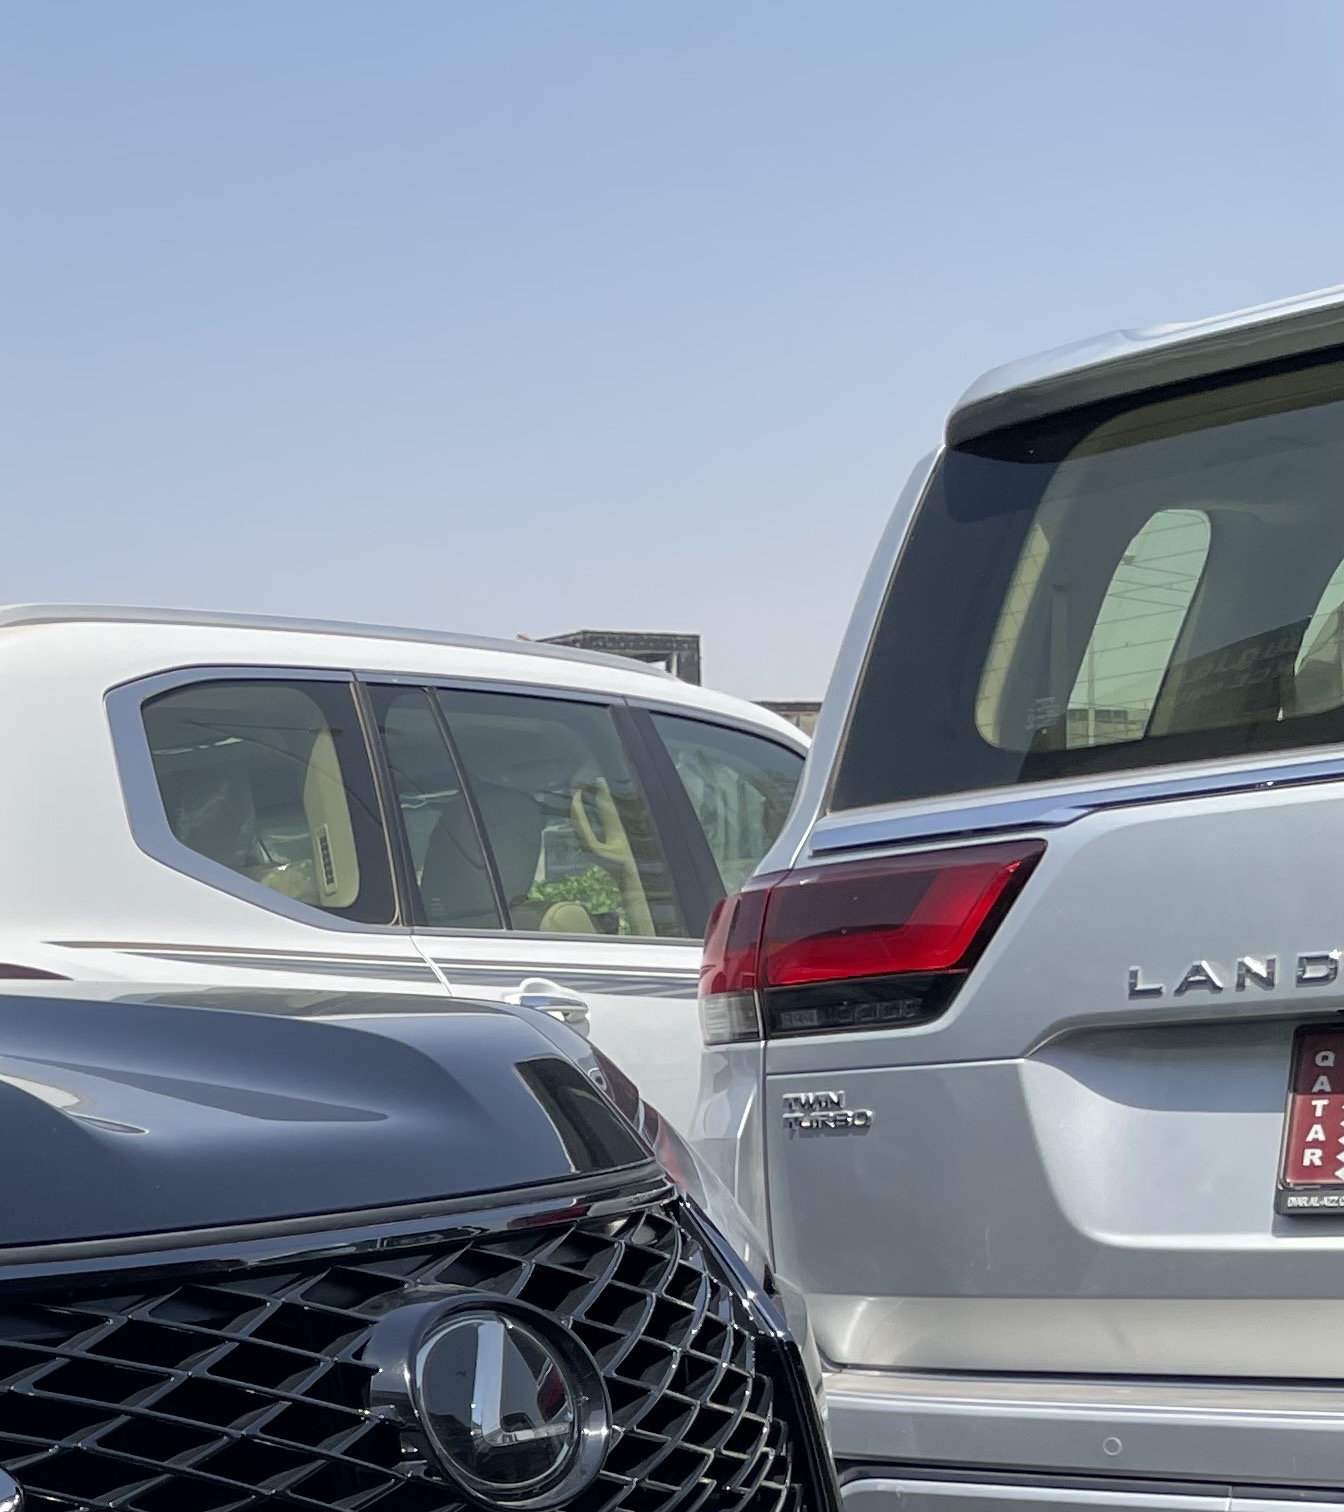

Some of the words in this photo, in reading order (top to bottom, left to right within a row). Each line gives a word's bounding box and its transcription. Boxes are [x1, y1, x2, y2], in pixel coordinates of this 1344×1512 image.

[1127, 951, 1339, 999] LAND
[782, 1090, 846, 1111] TWIN
[1301, 1050, 1336, 1168] QATAR
[782, 1109, 874, 1130] TURBO
